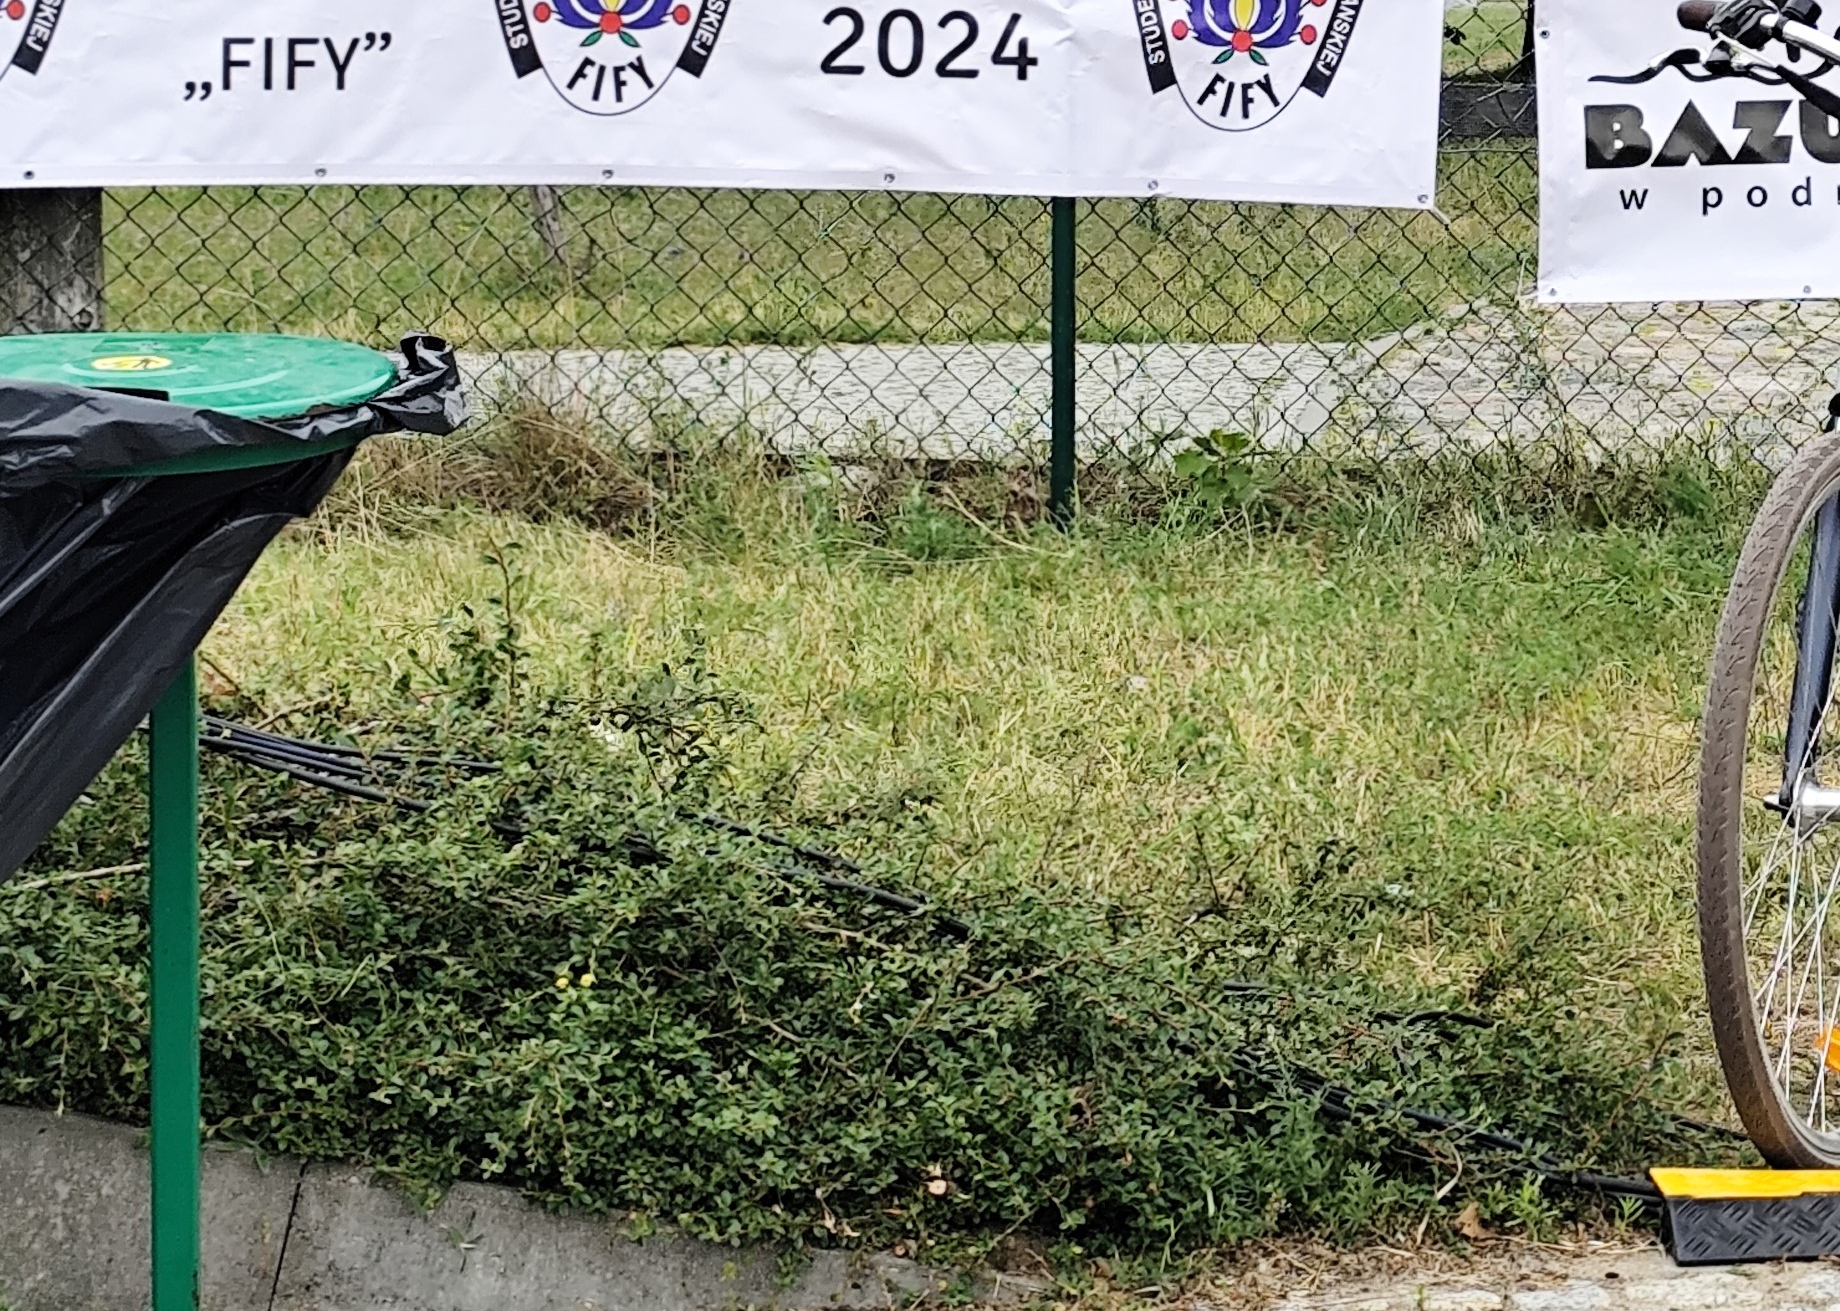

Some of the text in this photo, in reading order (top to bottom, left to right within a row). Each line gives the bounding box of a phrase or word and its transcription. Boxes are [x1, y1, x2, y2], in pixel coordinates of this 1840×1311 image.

[184, 31, 393, 101] „FIFY”
[819, 6, 1039, 81] 2024
[566, 55, 655, 103] FIFY
[1196, 72, 1281, 119] FIFY
[1619, 187, 1650, 211] w
